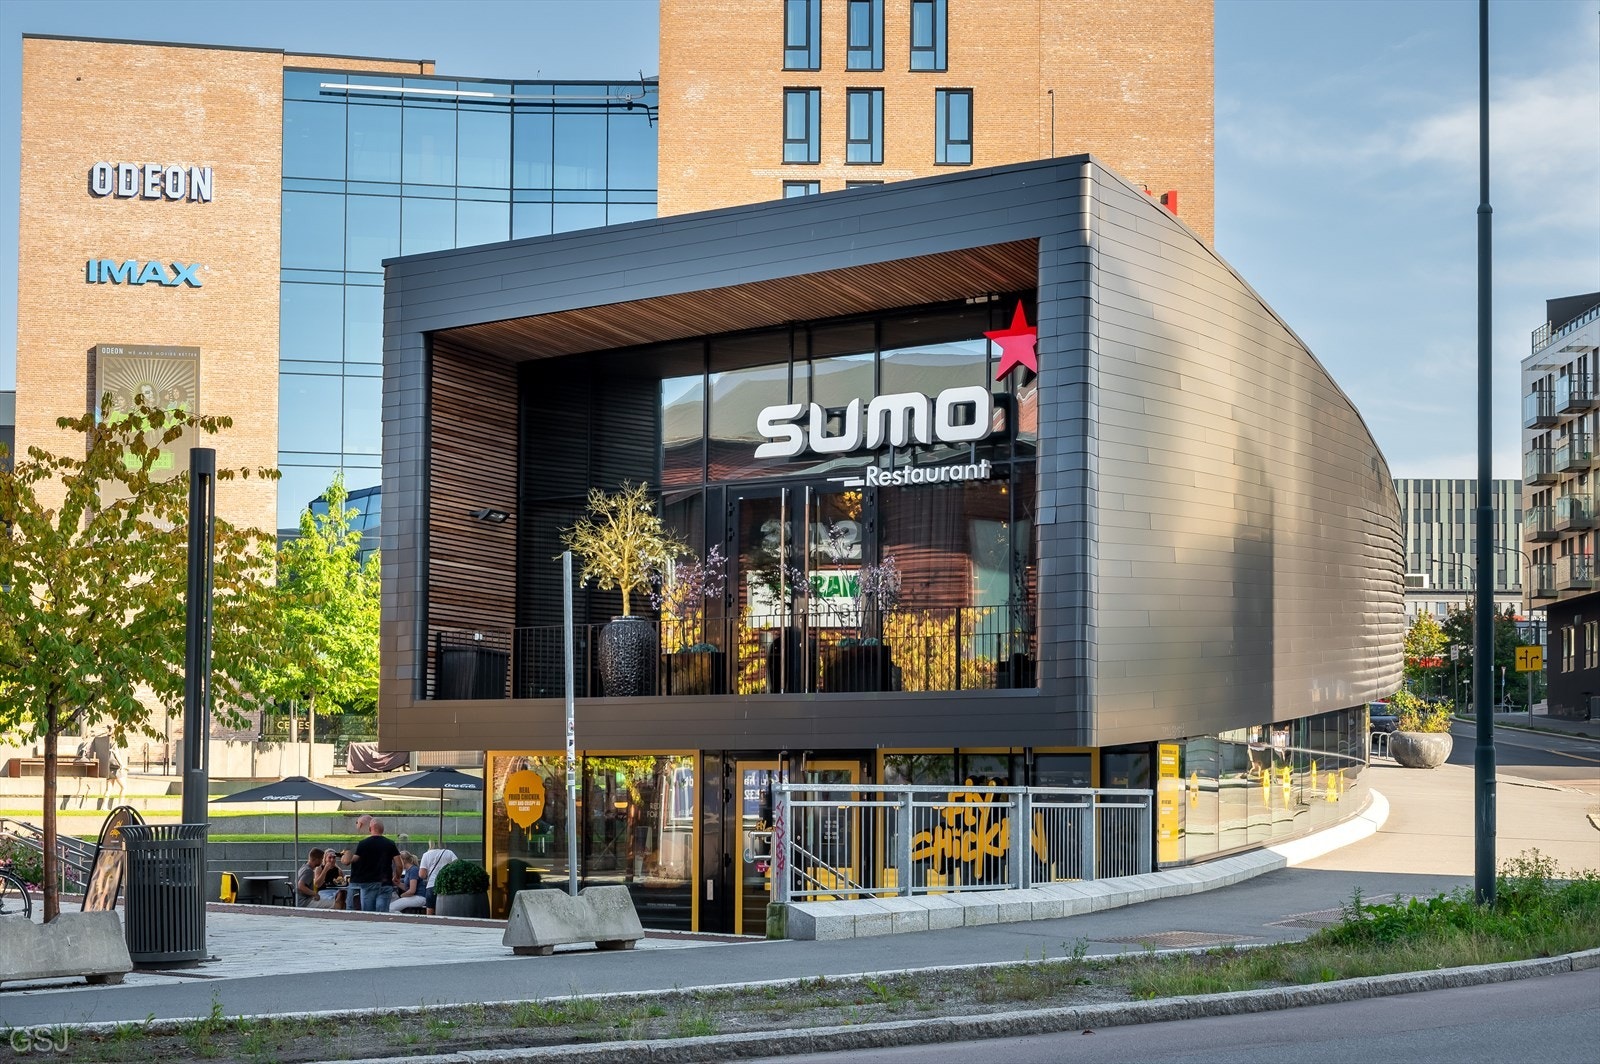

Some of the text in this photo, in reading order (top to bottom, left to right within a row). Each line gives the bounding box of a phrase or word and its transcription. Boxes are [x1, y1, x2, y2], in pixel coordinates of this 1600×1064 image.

[90, 162, 213, 202] ODEON
[87, 258, 203, 288] IMAX
[101, 347, 124, 355] ODEON
[866, 458, 992, 487] Restaurant
